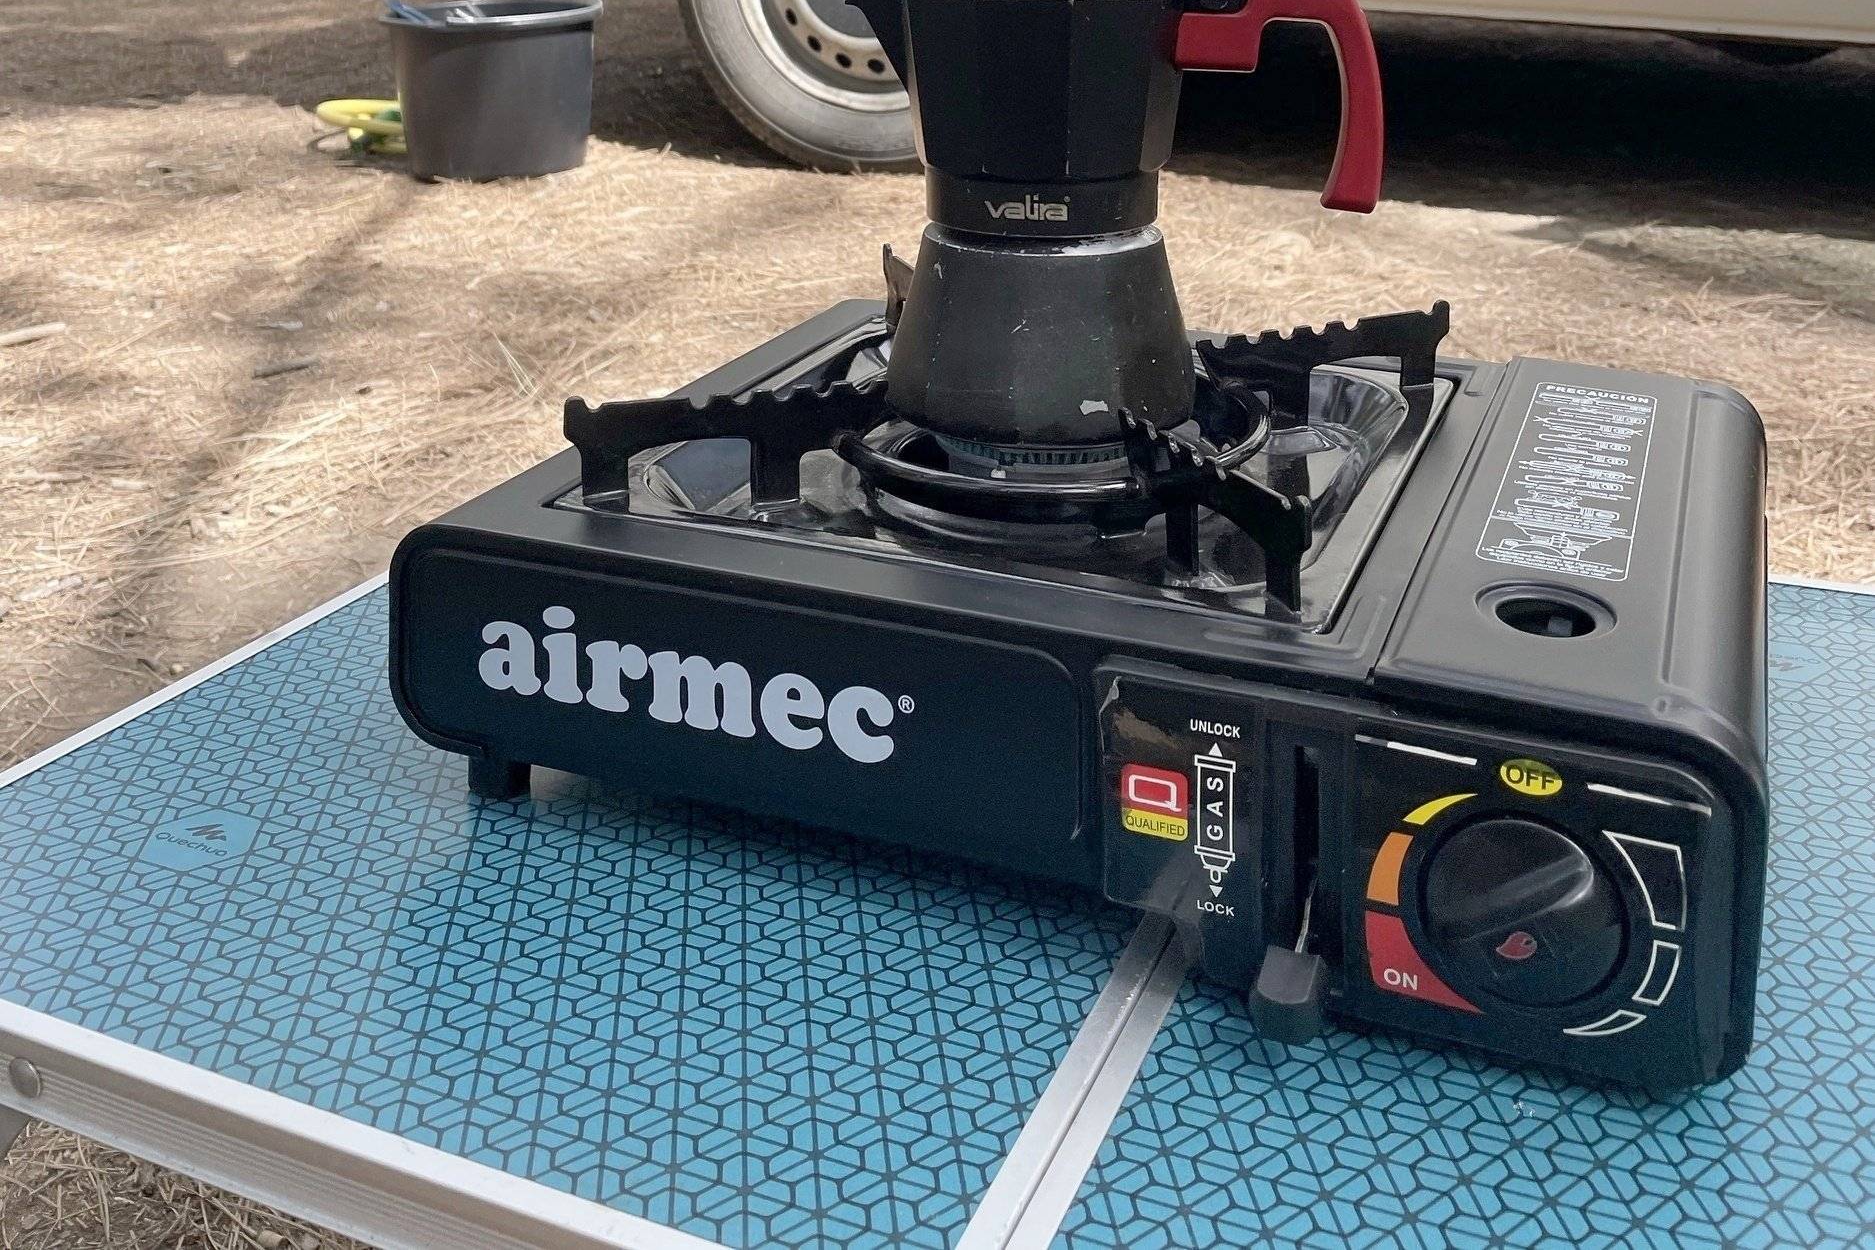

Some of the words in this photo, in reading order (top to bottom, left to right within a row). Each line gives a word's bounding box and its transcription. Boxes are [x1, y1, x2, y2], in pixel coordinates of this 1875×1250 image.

[984, 194, 1068, 221] valira
[1190, 718, 1240, 738] UNLOCK
[1505, 763, 1555, 791] OFF
[1206, 777, 1224, 841] GAS
[1126, 815, 1185, 837] QUALIFIED
[1197, 900, 1235, 917] LOCK
[1383, 968, 1419, 991] ON
